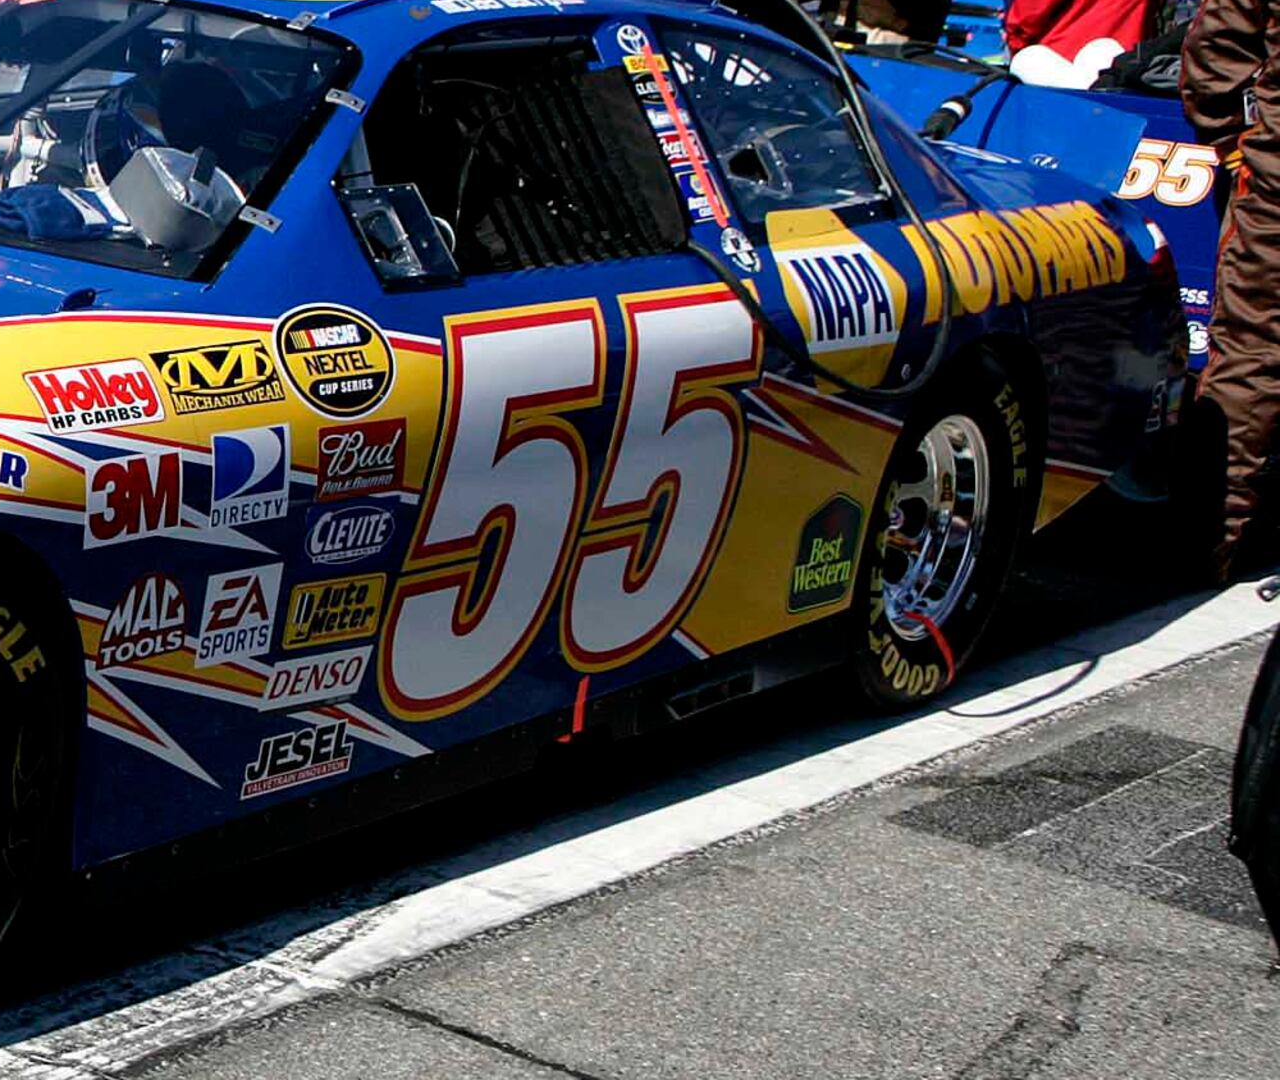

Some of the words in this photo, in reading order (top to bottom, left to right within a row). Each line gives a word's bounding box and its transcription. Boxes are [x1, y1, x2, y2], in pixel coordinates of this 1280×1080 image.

[788, 251, 893, 342] NAPA
[311, 323, 361, 347] NASCAR
[303, 349, 375, 377] NEXTEL
[30, 366, 158, 417] Holley
[172, 392, 245, 415] MECHANIX
[245, 381, 283, 404] WEAR
[318, 381, 339, 396] CUP
[340, 378, 375, 395] SERIES
[51, 413, 77, 430] HP
[80, 405, 143, 427] CARBS
[321, 428, 403, 477] Bud
[89, 454, 180, 541] 3M
[211, 497, 285, 528] DIRECTV
[378, 280, 763, 721] 55
[310, 511, 391, 555] CLEVITE
[809, 536, 844, 565] Best
[793, 557, 852, 594] Western
[102, 576, 186, 643] MAC
[204, 574, 269, 634] EA
[316, 582, 370, 611] Auto
[310, 605, 375, 636] Meter
[100, 629, 185, 667] TOOLS
[199, 623, 270, 661] SPORTS
[268, 655, 363, 701] DENSO
[246, 720, 352, 782] JESEL
